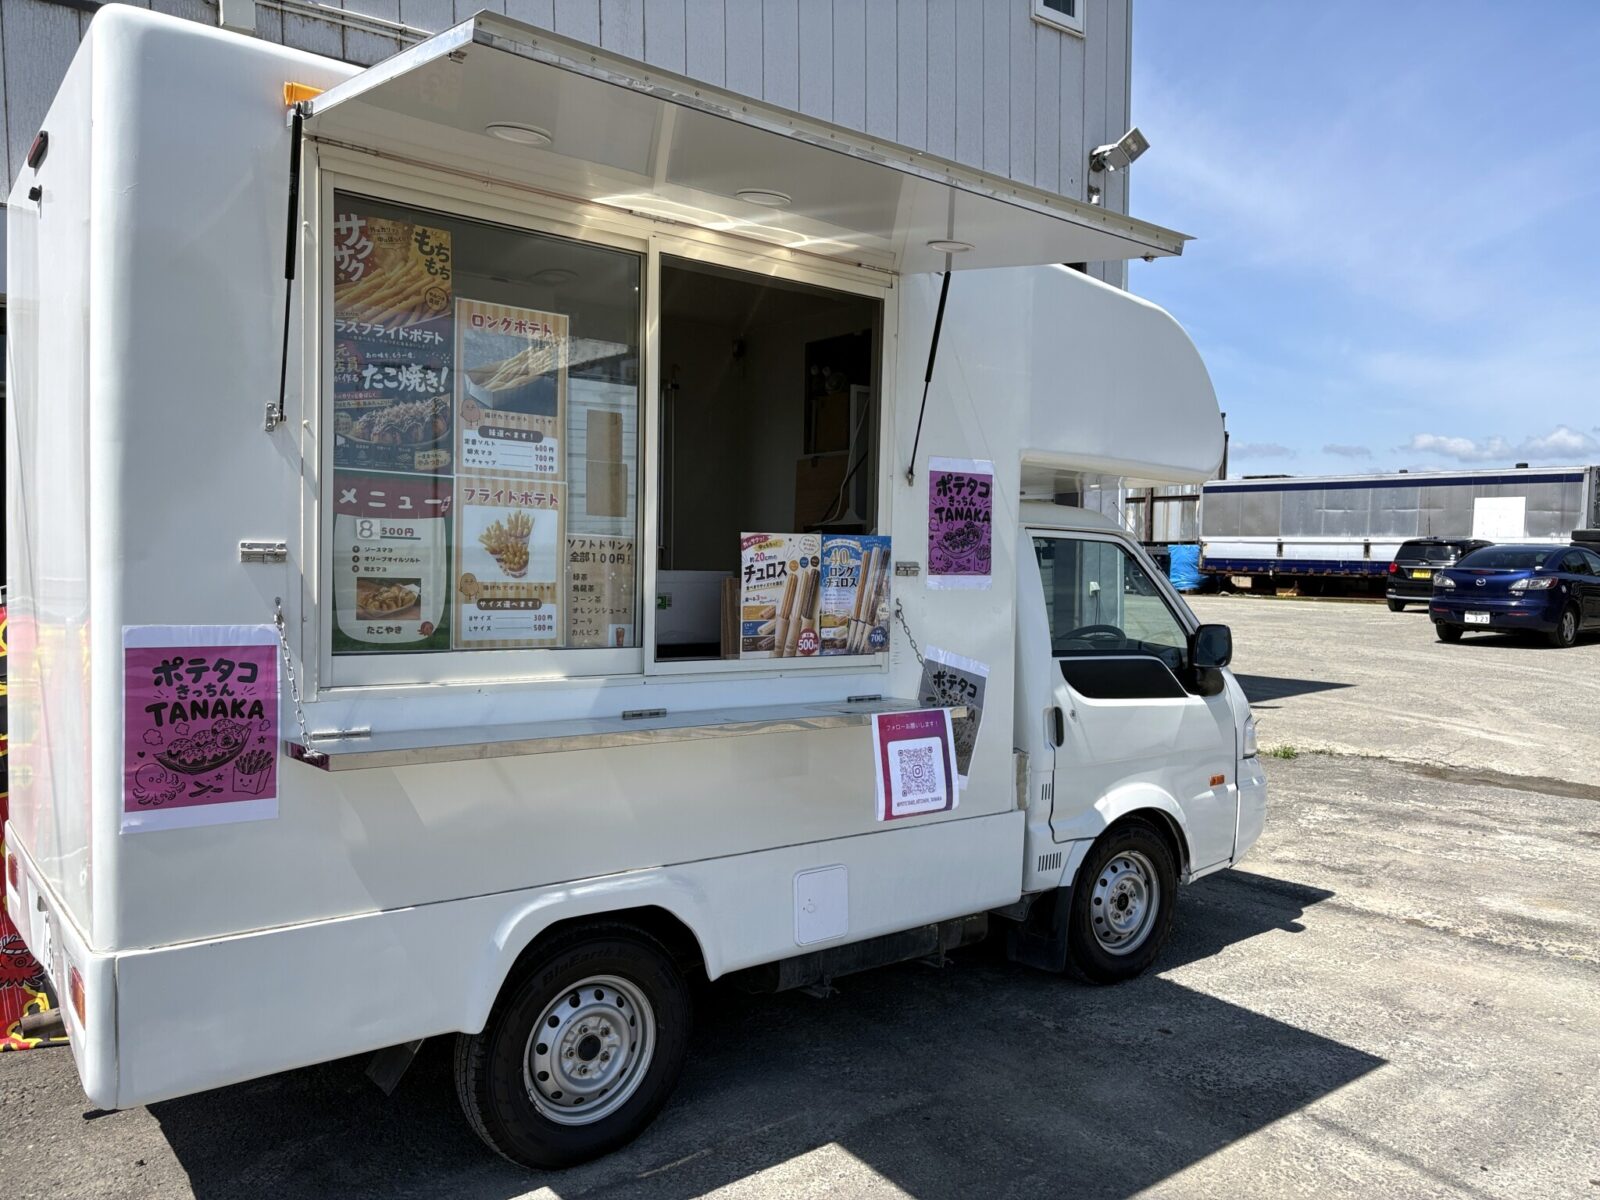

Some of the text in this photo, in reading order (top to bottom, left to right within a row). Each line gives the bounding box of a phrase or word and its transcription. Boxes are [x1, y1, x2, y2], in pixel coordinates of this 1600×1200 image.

[472, 314, 552, 337] ロングポテト
[936, 473, 990, 498] ポテタコ
[339, 488, 442, 509] メニュー
[464, 488, 558, 506] フライドポテト
[948, 495, 976, 507] きっちん
[934, 506, 991, 524] TANAKA
[359, 520, 414, 538] 8 500円
[567, 539, 633, 551] ソフトドリンク
[744, 560, 787, 583] チュロス
[830, 566, 854, 577] ロング
[826, 577, 857, 588] チュロス
[366, 626, 402, 634] たこやき
[152, 656, 258, 686] ポテタコ
[176, 682, 235, 700] きっちん
[933, 670, 977, 698] ポテタコ
[145, 698, 264, 727] TANAKA
